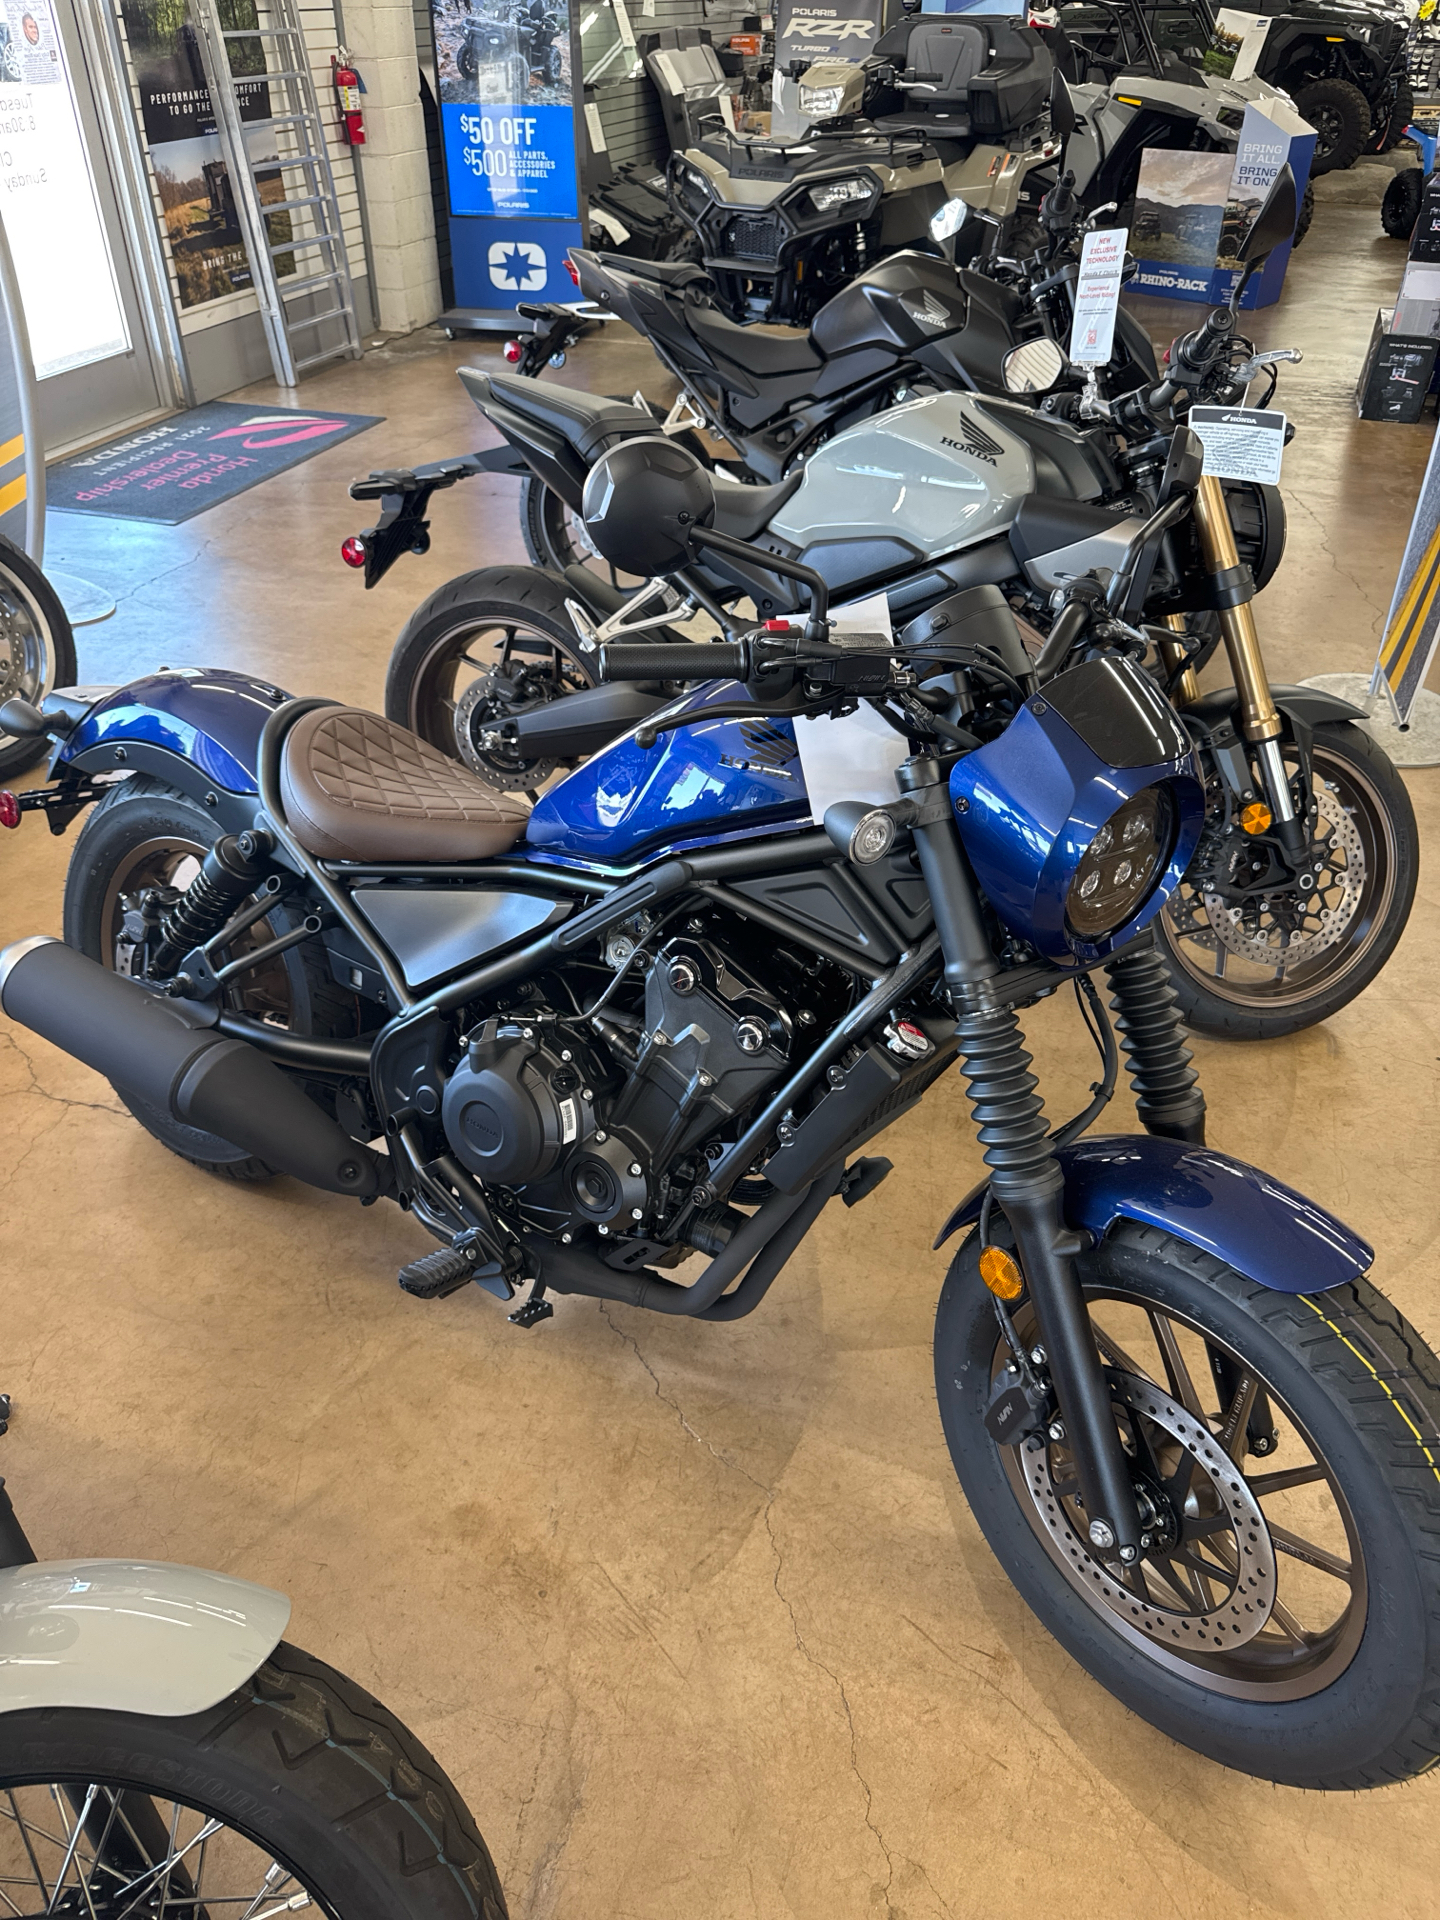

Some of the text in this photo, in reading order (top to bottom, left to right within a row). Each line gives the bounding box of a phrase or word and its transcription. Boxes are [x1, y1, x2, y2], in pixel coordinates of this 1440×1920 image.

[792, 7, 837, 17] POLARIS
[782, 17, 875, 41] RZR
[149, 88, 210, 105] PERFORMANCE
[169, 101, 211, 116] TO GO THE
[460, 113, 537, 146] $50 OFF
[1243, 143, 1283, 155] BRING
[463, 146, 549, 177] $500 ALL PARTS,
[509, 160, 556, 170] ACCESSORIES
[1241, 153, 1281, 165] IT ALL.
[517, 169, 549, 178] APPAREL
[738, 167, 785, 179] POLARIS
[1239, 166, 1278, 177] BRING
[1236, 176, 1272, 187] IT ON.
[497, 201, 530, 209] POLARIS
[1098, 237, 1112, 245] NEW
[227, 250, 243, 262] THE
[1089, 245, 1118, 255] EXCLUSIVE
[1086, 254, 1120, 265] TECHNOLOGY
[1140, 273, 1209, 292] RHINO-RACK
[913, 311, 947, 329] HONDA
[1229, 416, 1257, 425] HONDA
[70, 426, 179, 468] HONDA
[939, 436, 998, 468] HONDA
[93, 440, 175, 476] RECIPIENT
[76, 450, 199, 501] Dealership
[141, 452, 229, 491] Premier
[178, 456, 259, 489] Honda
[718, 753, 795, 783] HONDA
[466, 1117, 499, 1139] HONDA
